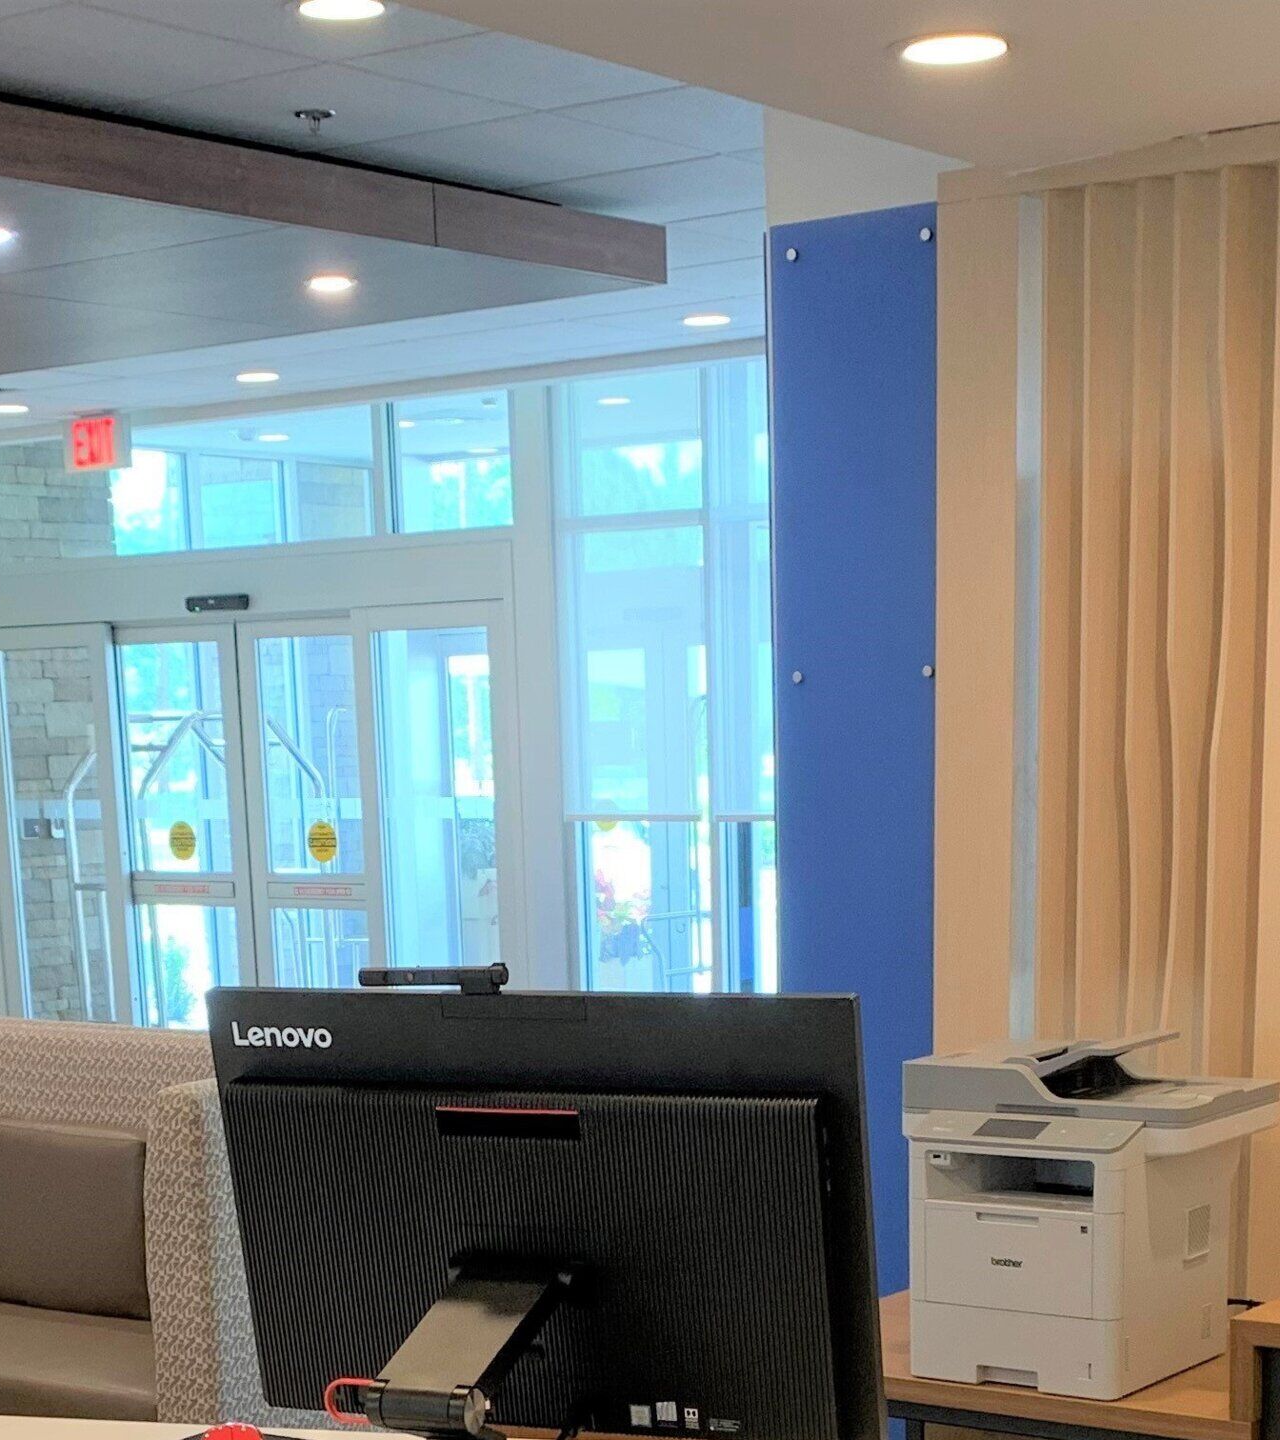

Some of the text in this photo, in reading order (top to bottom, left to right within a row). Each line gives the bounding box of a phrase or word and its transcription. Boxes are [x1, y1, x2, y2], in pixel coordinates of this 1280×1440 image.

[72, 418, 115, 468] EXIT
[230, 1020, 333, 1049] Lenovo
[990, 1256, 1023, 1269] brother
